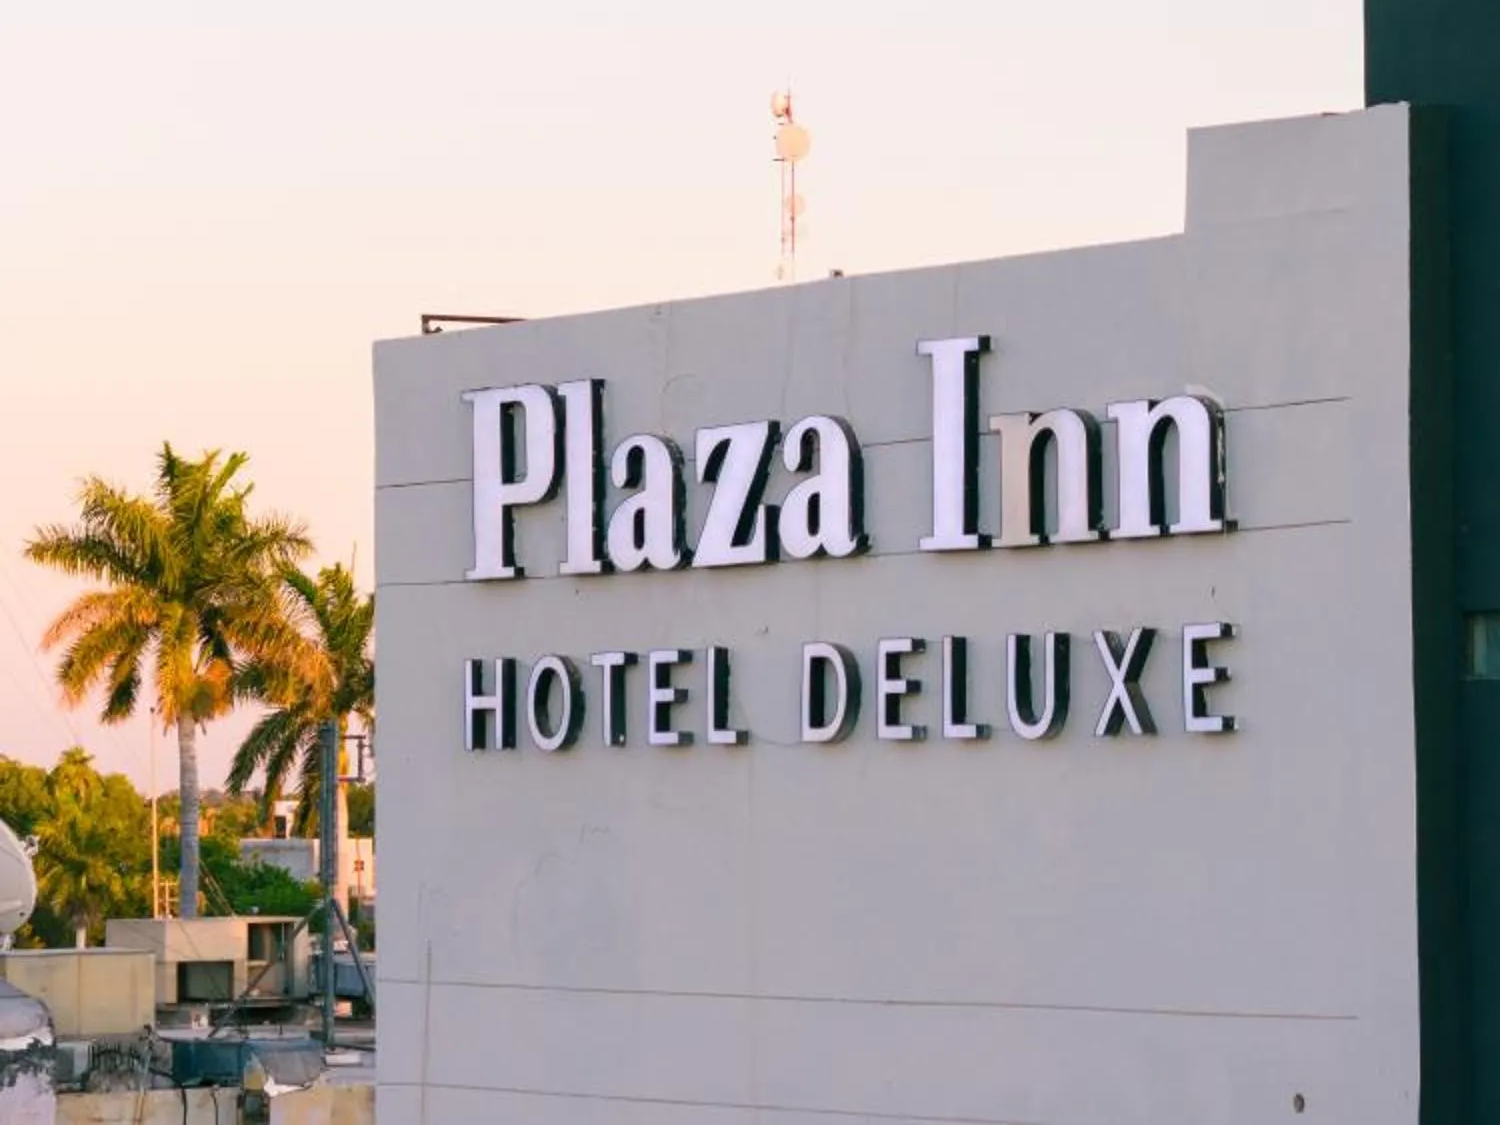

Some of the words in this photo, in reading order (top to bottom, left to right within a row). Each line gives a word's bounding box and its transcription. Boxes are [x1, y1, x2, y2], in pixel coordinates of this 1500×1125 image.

[463, 378, 870, 581] Plaza
[918, 335, 1238, 552] Inn
[463, 647, 750, 751] HOTEL
[801, 622, 1239, 744] DELUXE
